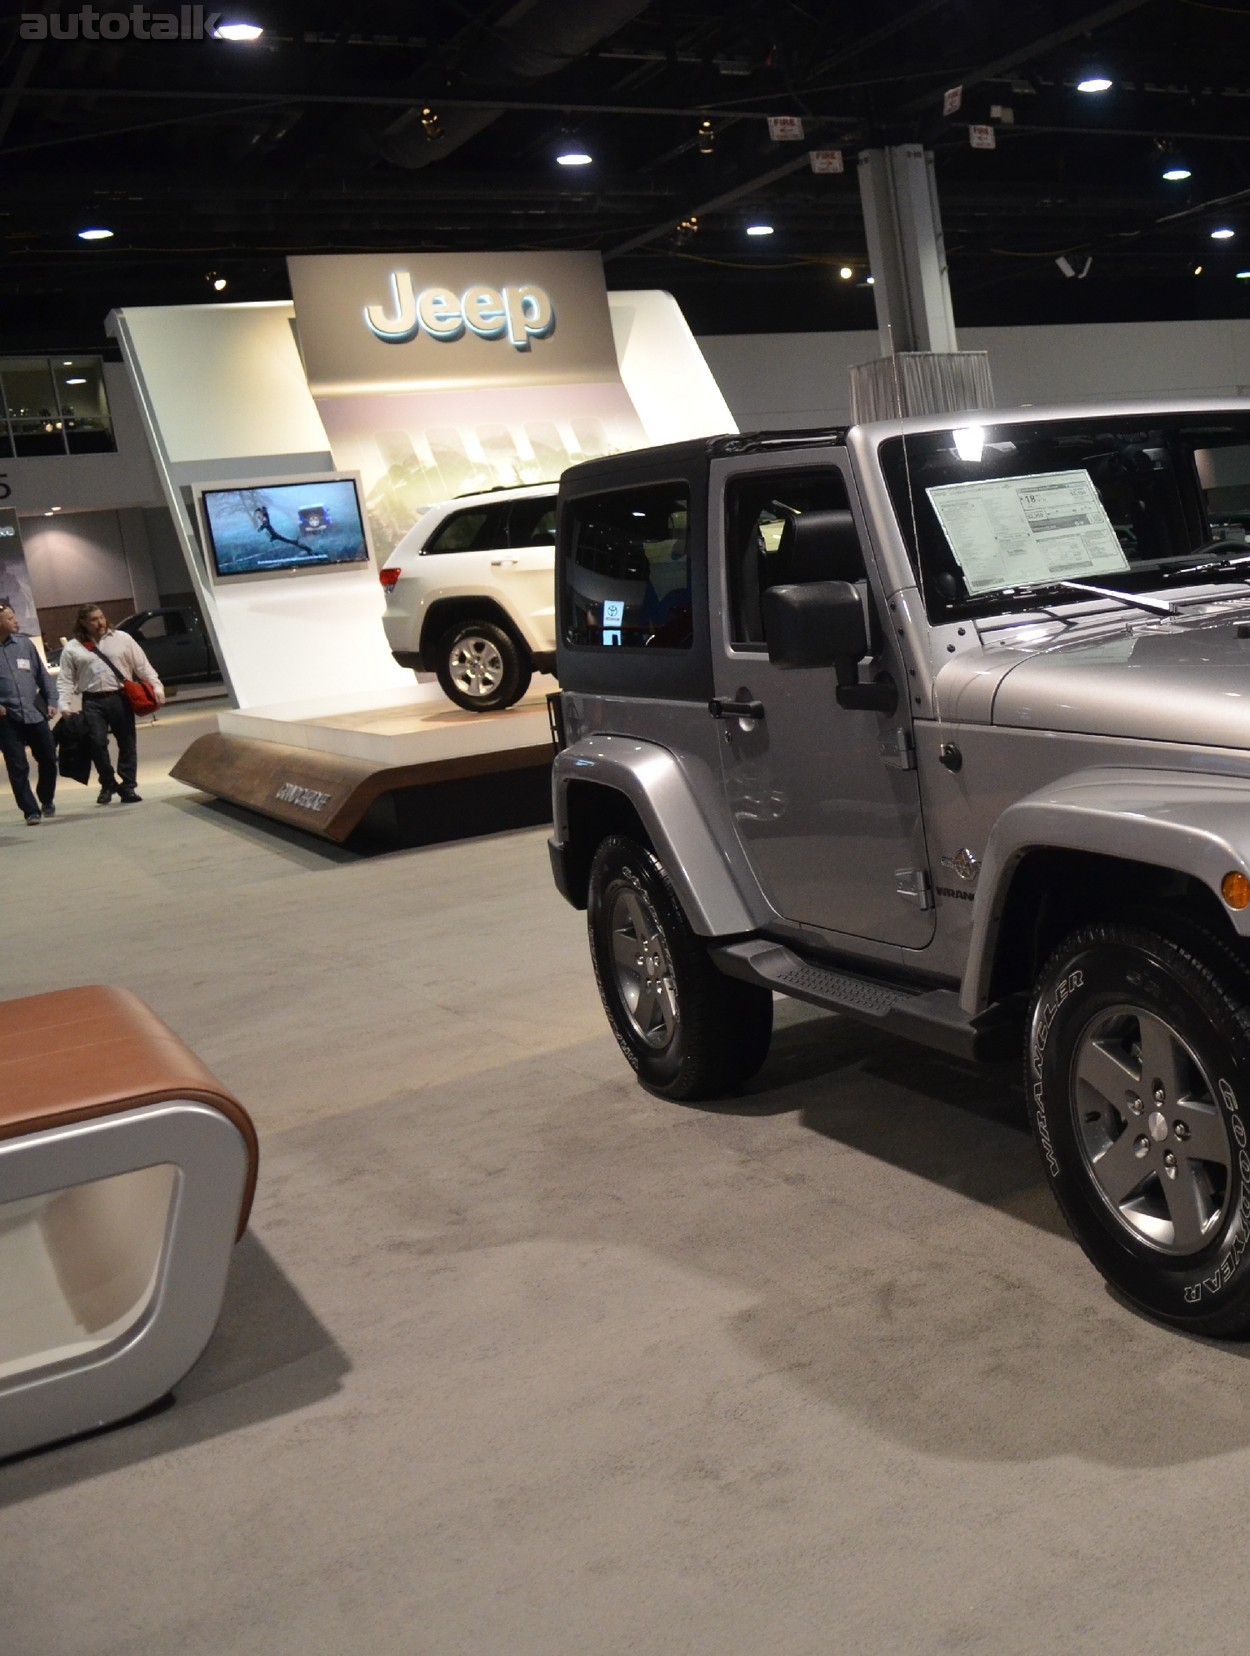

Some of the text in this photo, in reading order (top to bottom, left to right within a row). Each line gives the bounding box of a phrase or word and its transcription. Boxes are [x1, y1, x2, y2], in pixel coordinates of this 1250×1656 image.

[774, 118, 796, 127] FIRE
[815, 151, 837, 160] FIRE
[365, 271, 555, 346] Jeep
[1032, 969, 1084, 1178] WRANGLER
